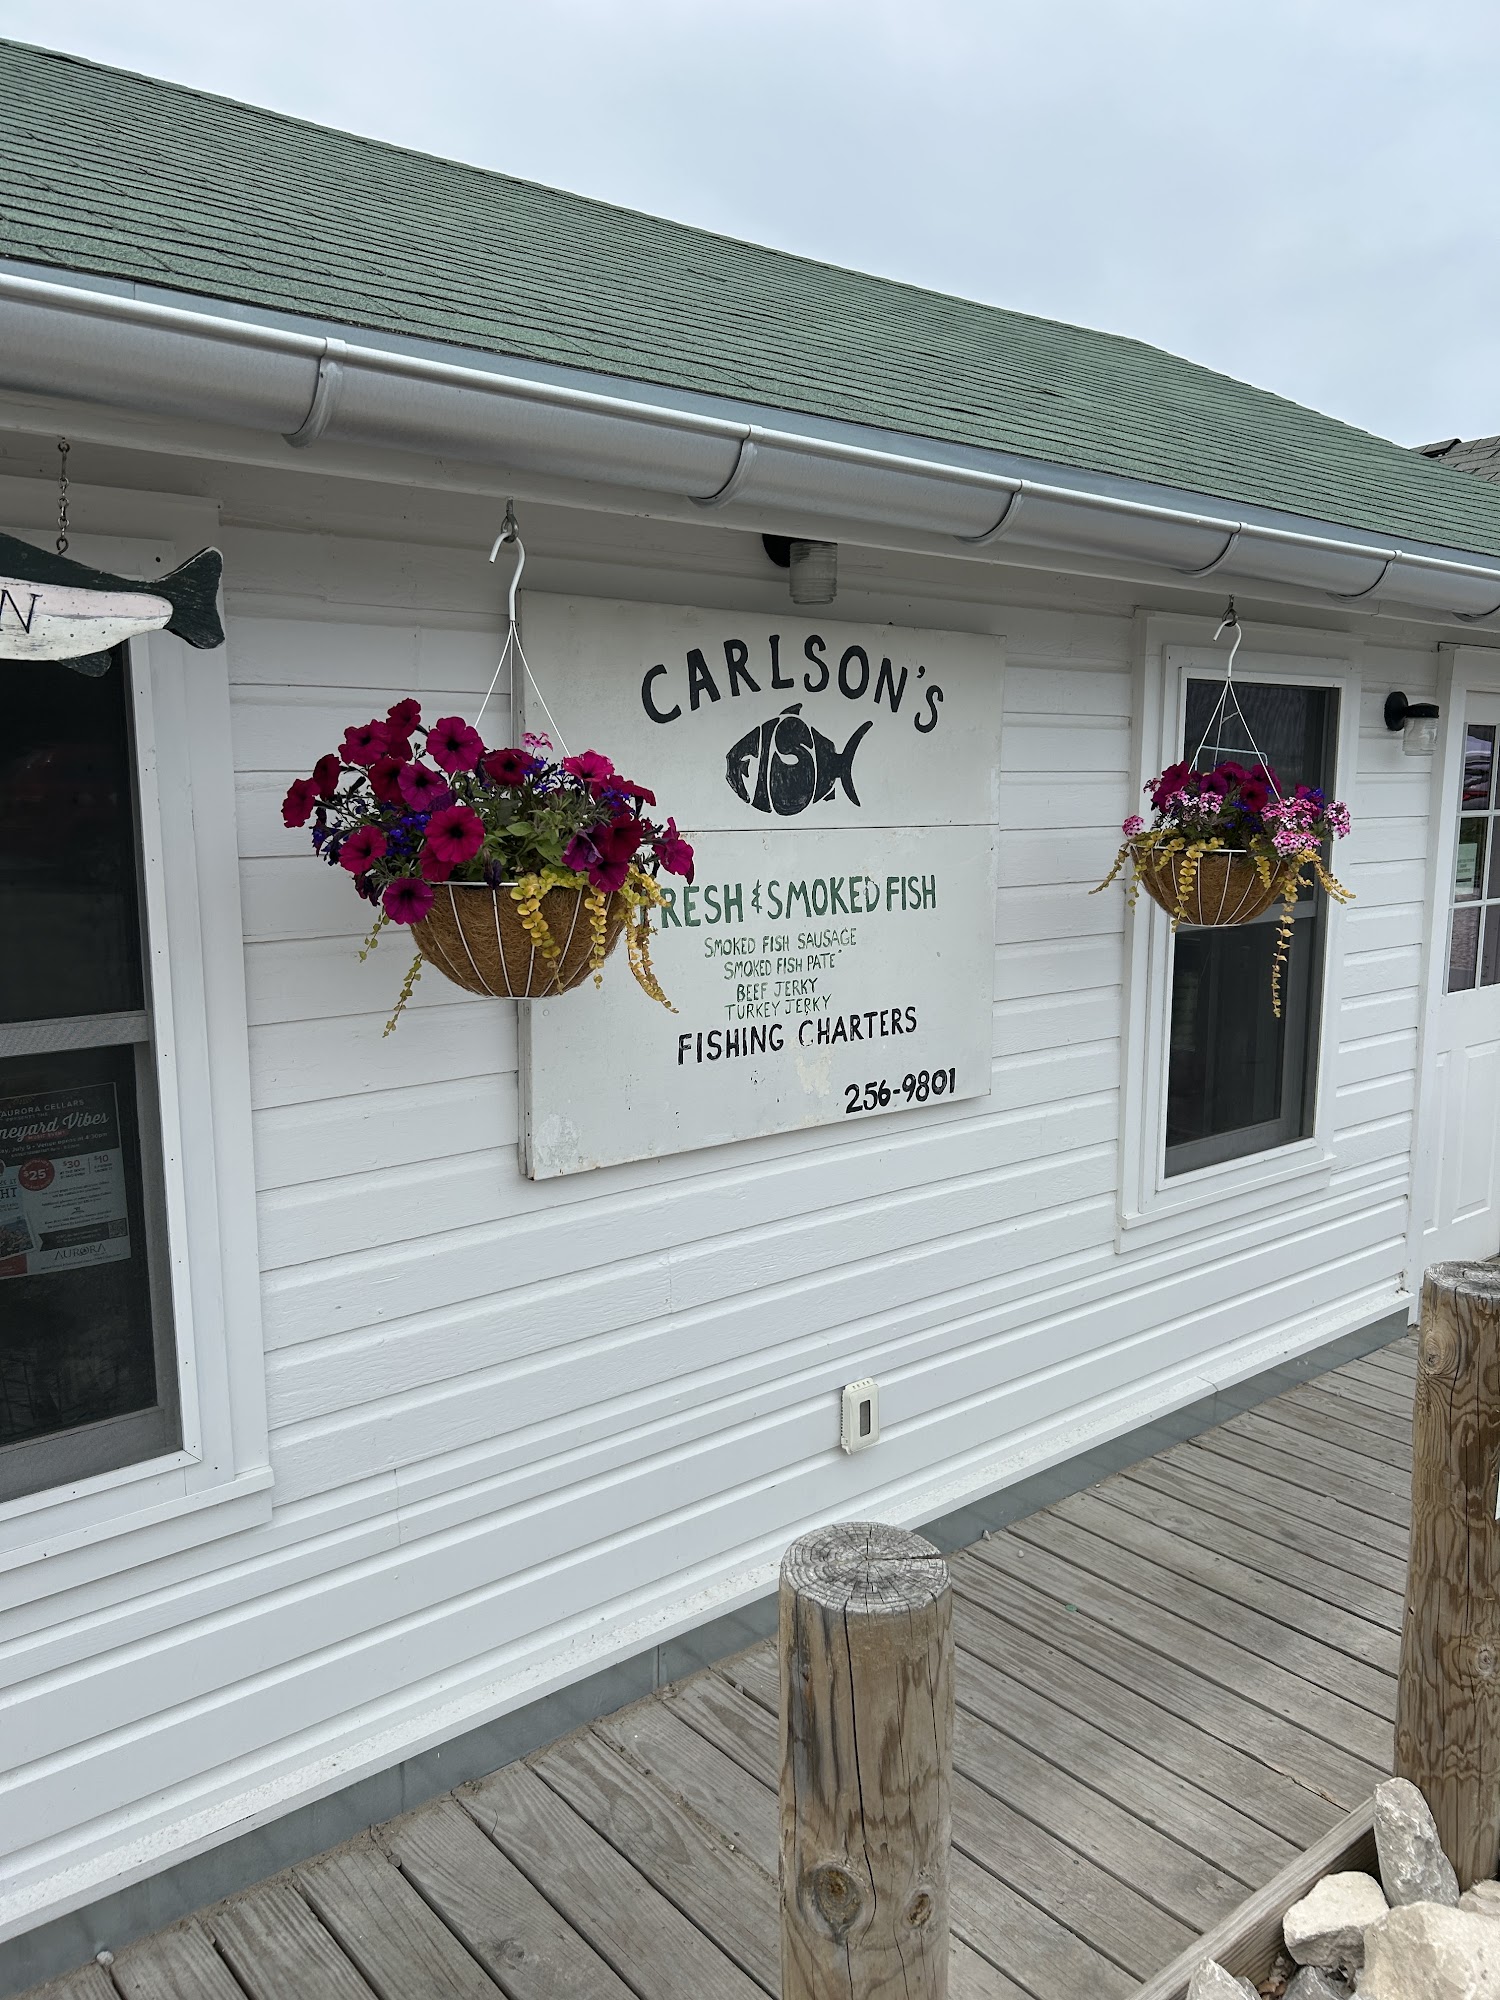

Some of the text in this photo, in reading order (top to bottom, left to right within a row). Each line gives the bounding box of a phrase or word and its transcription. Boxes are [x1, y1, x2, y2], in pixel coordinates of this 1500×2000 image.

[641, 634, 944, 734] CARLSON'S
[725, 703, 873, 816] FISH
[751, 879, 763, 914] &
[767, 876, 880, 920] SMOKED
[886, 875, 937, 912] FISH
[704, 927, 857, 959] SMOKED FISH SAUSAGE
[724, 960, 772, 980] SMOKED
[777, 956, 803, 974] FISH
[736, 978, 818, 1002] BEEF JERKY
[724, 993, 832, 1021] TURKEY JERKY
[677, 1006, 918, 1066] FISHING CHARTERS
[844, 1067, 957, 1114] 256-9801
[0, 1098, 85, 1118] AURORA CELLARS
[62, 1111, 110, 1130] Vibes
[63, 1154, 109, 1169] $30 $10
